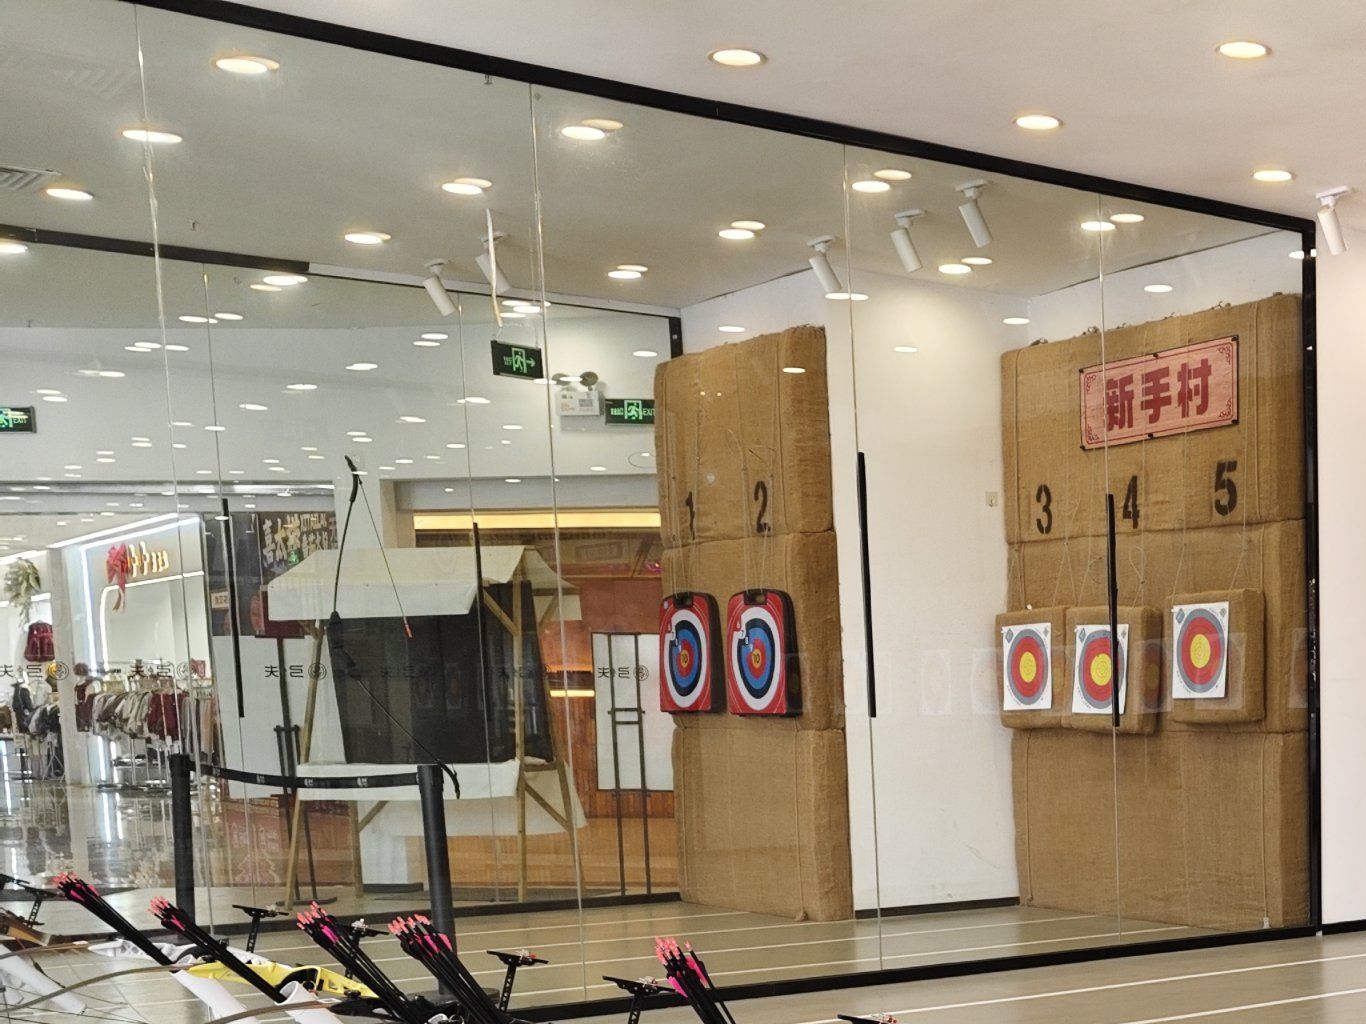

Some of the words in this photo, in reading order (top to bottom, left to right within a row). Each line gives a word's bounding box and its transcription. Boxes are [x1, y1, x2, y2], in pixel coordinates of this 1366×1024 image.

[1105, 358, 1212, 431] 新手村
[685, 491, 696, 540] 1
[753, 480, 771, 534] 2
[1035, 484, 1053, 535] 3
[1122, 475, 1140, 530] 4
[1214, 460, 1238, 517] 5
